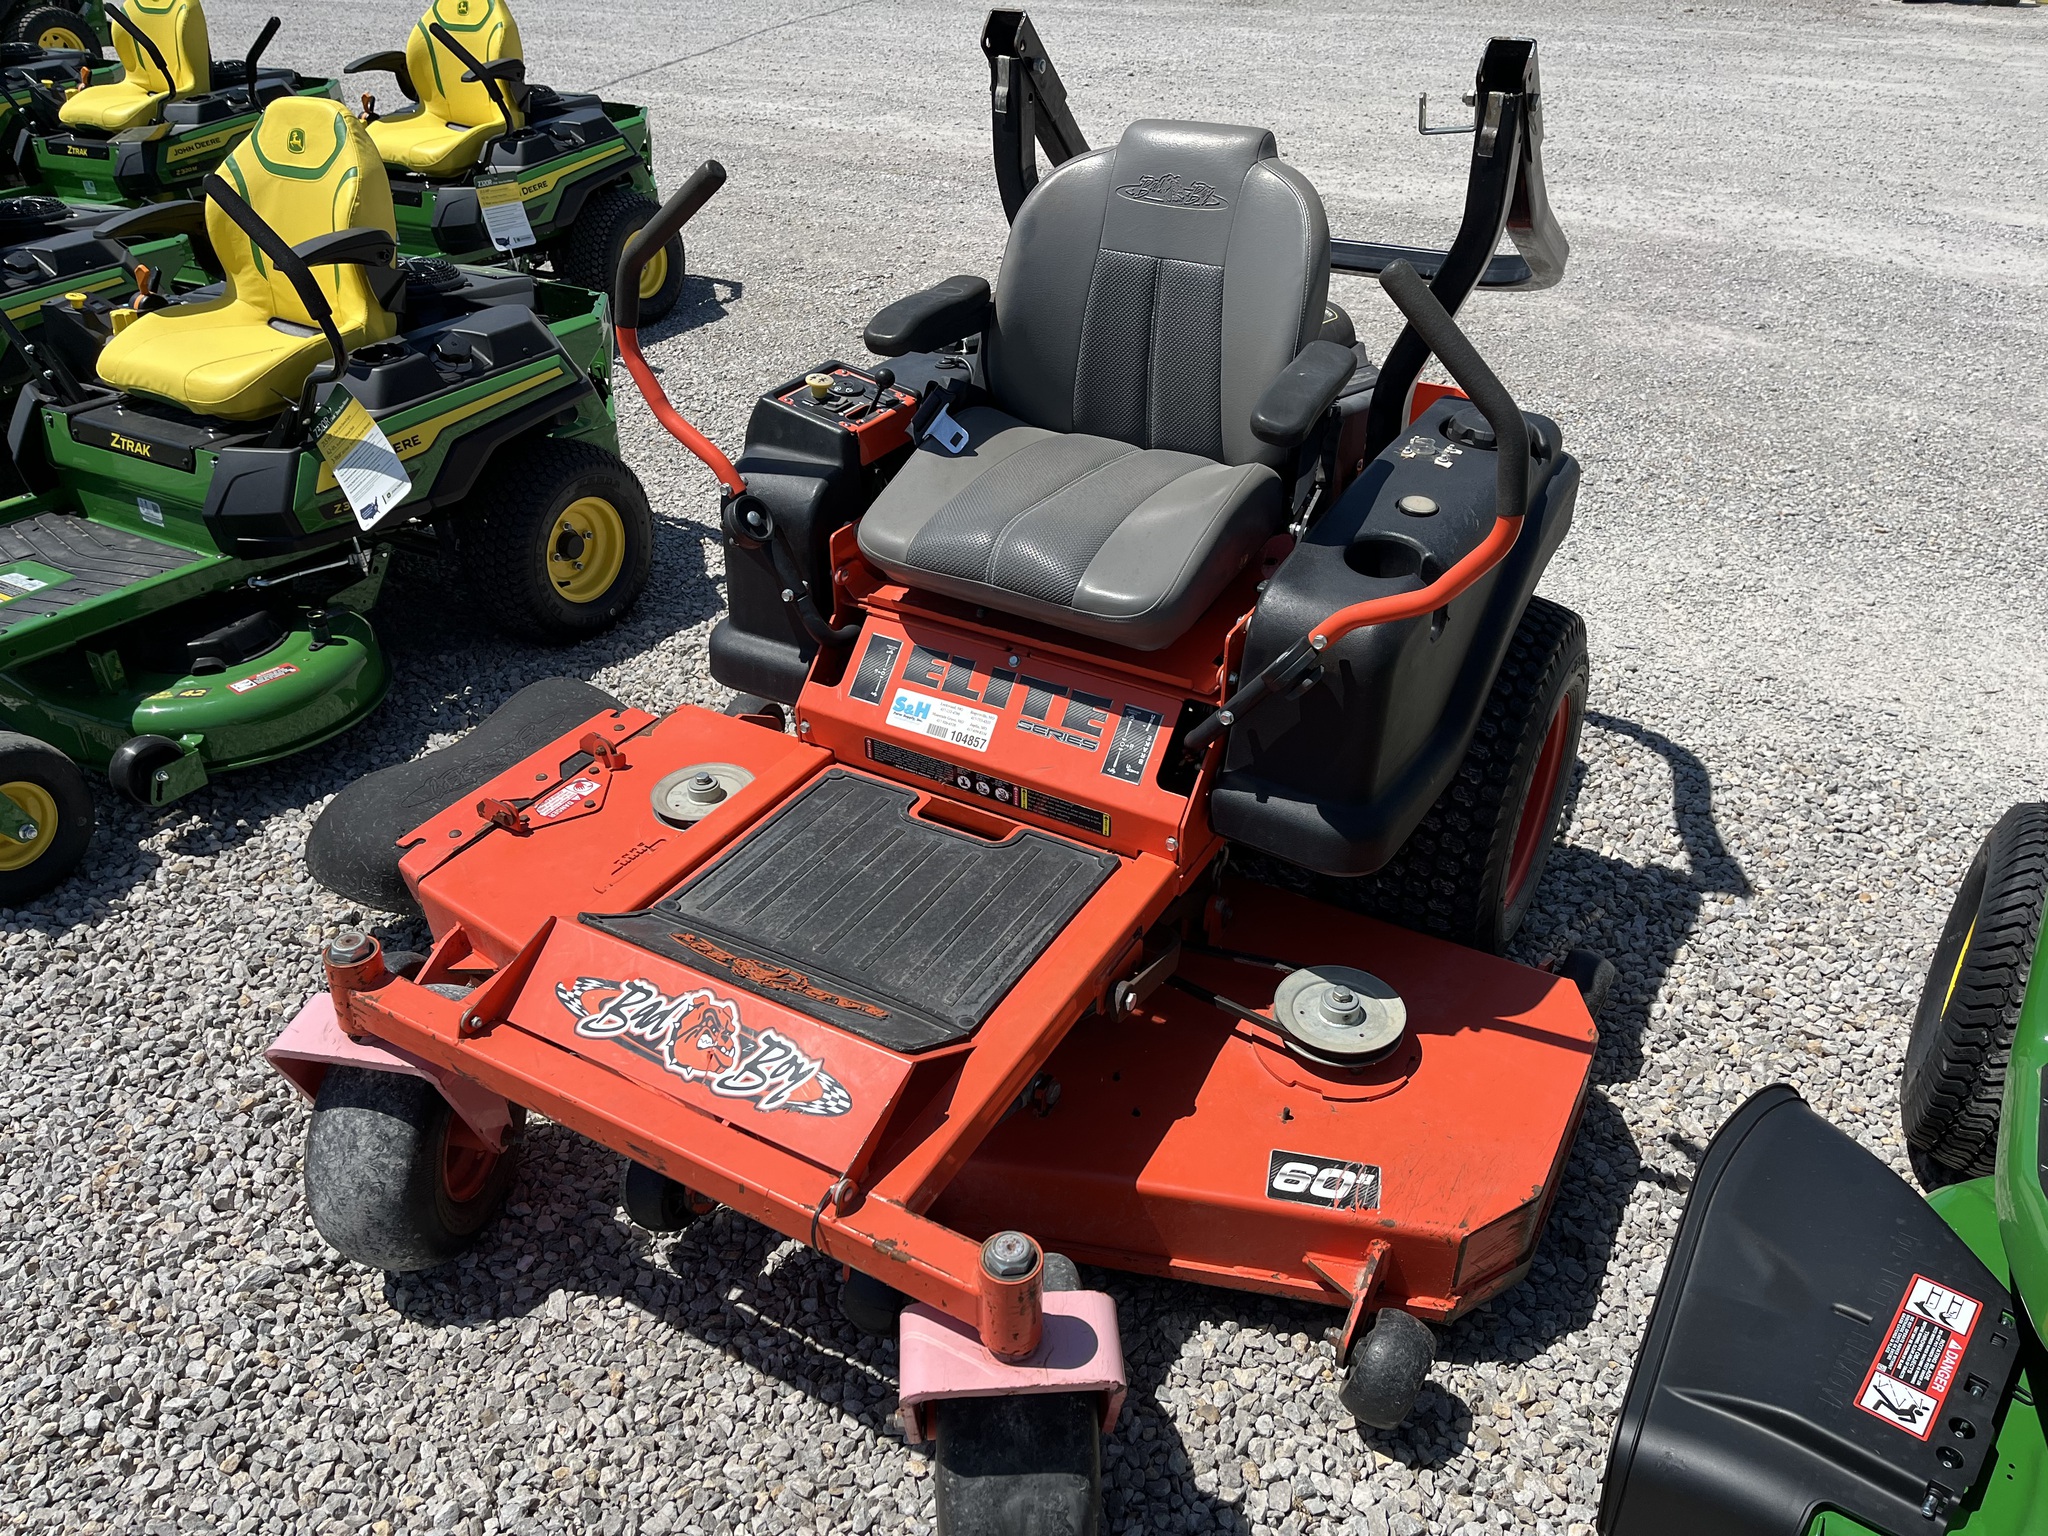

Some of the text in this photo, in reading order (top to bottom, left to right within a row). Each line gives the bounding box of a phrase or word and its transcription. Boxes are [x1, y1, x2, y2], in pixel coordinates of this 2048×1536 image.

[174, 137, 221, 156] JOHN DEERE
[522, 180, 548, 196] DEERE
[313, 417, 331, 438] Z320R
[110, 433, 151, 457] ZTRAK
[393, 435, 422, 452] ERE
[334, 502, 351, 514] Z3
[901, 644, 1113, 738] ELITE
[893, 696, 931, 719] S&H
[950, 730, 986, 749] 104857
[1015, 719, 1101, 753] SERIES
[1137, 735, 1152, 765] BRAKE
[574, 978, 824, 1111] Bad Boy
[1906, 1329, 1930, 1374] THROWN OBJECTS
[1923, 1338, 1946, 1381] ROTATING BLADE
[1929, 1348, 1960, 1393] DANGER
